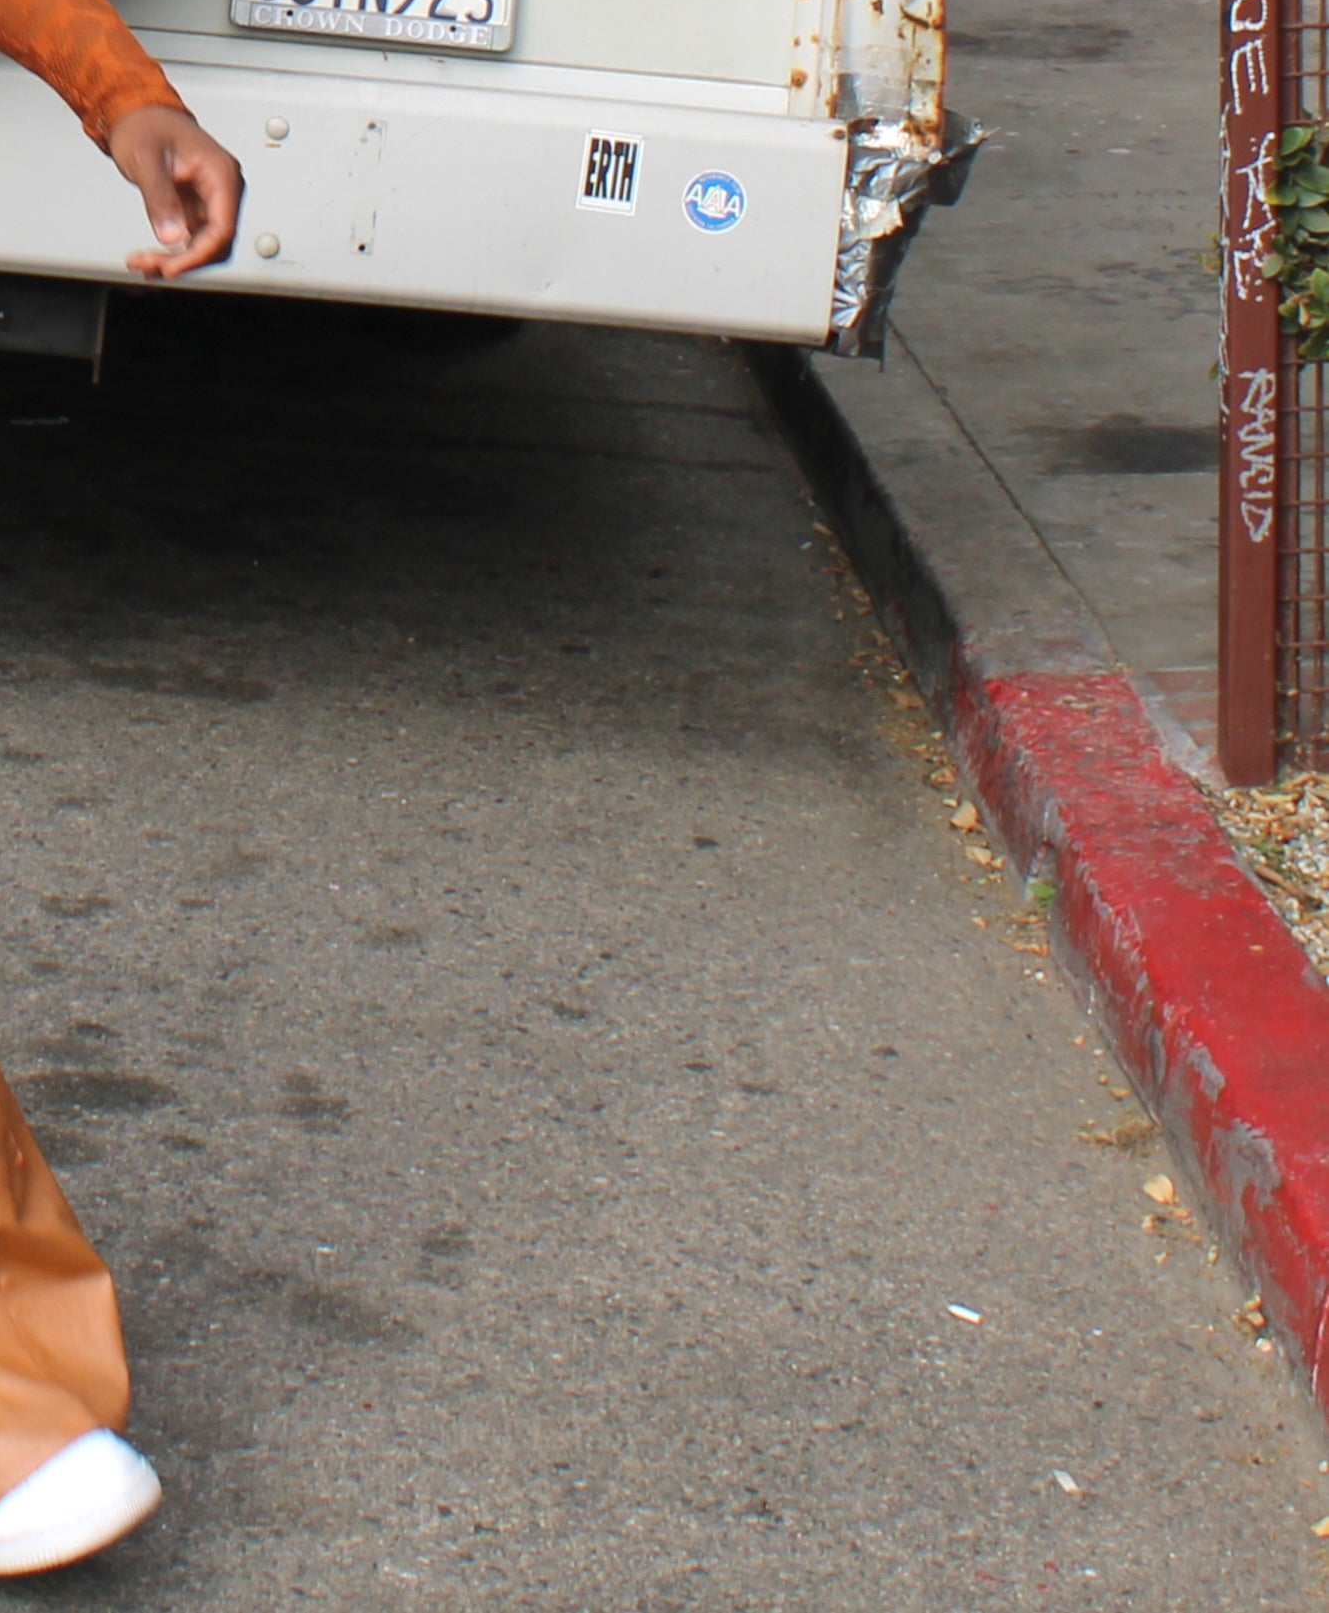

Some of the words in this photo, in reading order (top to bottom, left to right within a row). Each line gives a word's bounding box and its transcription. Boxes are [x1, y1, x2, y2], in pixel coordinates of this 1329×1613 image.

[254, 6, 365, 33] CROWN
[386, 18, 489, 46] DODGE
[584, 137, 638, 202] ERTH
[685, 184, 741, 218] AAA
[1237, 367, 1276, 543] RANCID
